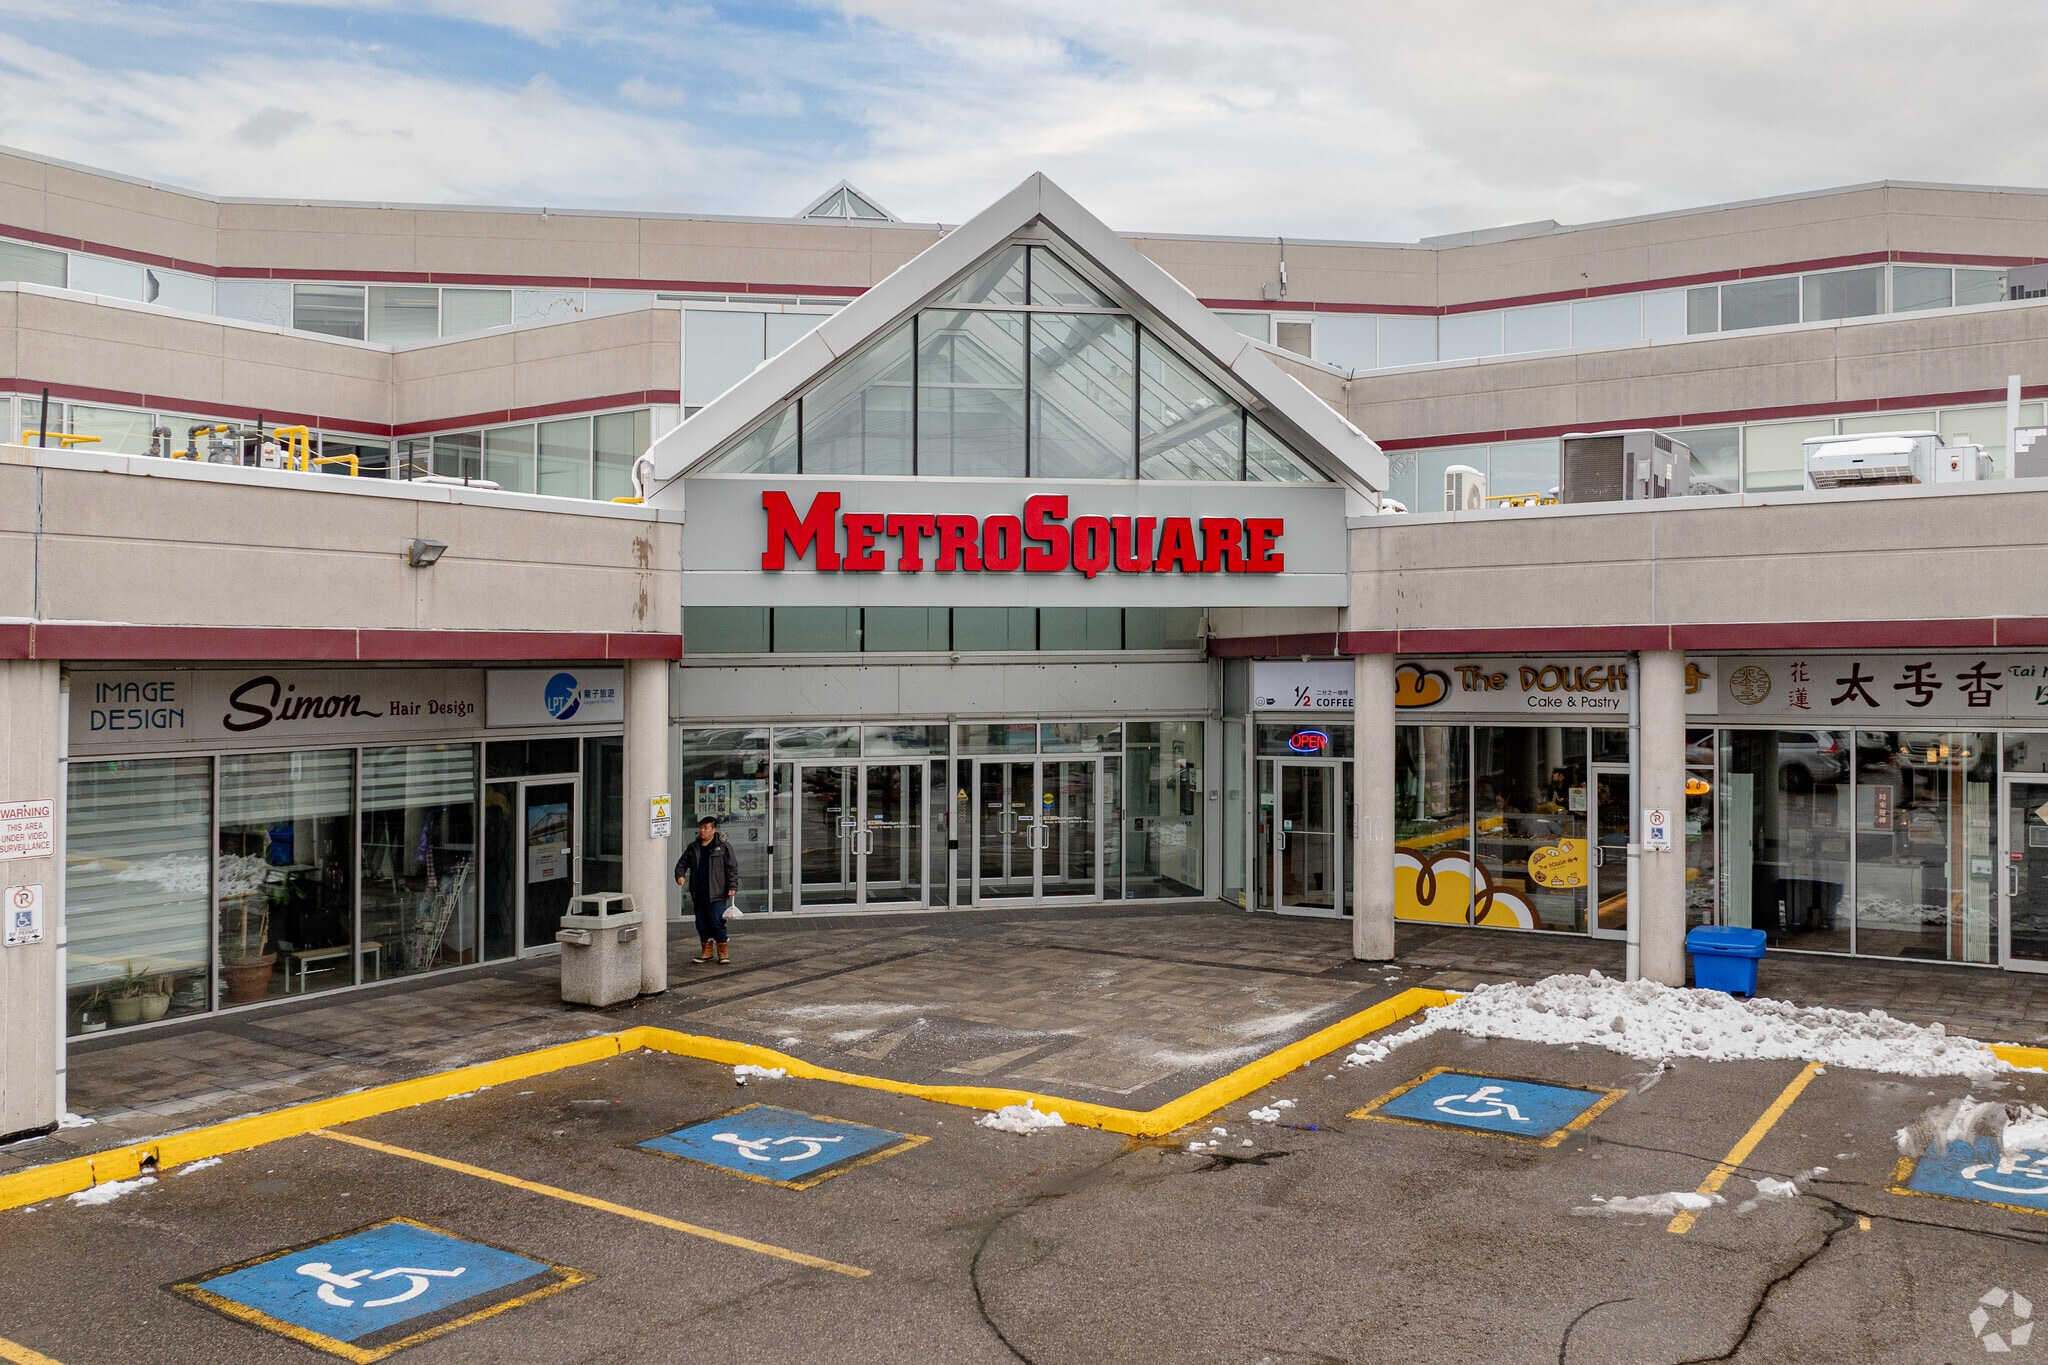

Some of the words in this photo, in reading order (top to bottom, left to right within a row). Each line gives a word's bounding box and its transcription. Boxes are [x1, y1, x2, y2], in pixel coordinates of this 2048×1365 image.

[2008, 665, 2035, 677] Tai
[1454, 665, 1507, 692] The
[1519, 664, 1629, 693] DOUGH
[1789, 661, 1812, 710] 花蓮
[96, 682, 175, 703] IMAGE
[223, 675, 384, 732] Simon
[390, 700, 421, 716] Hair
[428, 700, 475, 717] Design
[548, 696, 565, 711] LPT
[1316, 698, 1354, 707] COFFEE
[1527, 696, 1563, 708] Cake
[1567, 697, 1577, 708] &
[1581, 696, 1620, 710] Pastry
[90, 708, 185, 731] DESIGN
[1291, 734, 1327, 749] OPEN
[0, 806, 50, 819] WARNING
[7, 823, 22, 832] THIS
[25, 821, 43, 831] AREA
[1, 833, 25, 843] UNDER
[28, 831, 48, 841] VIDEO
[0, 840, 50, 853] SURVEILLANCE
